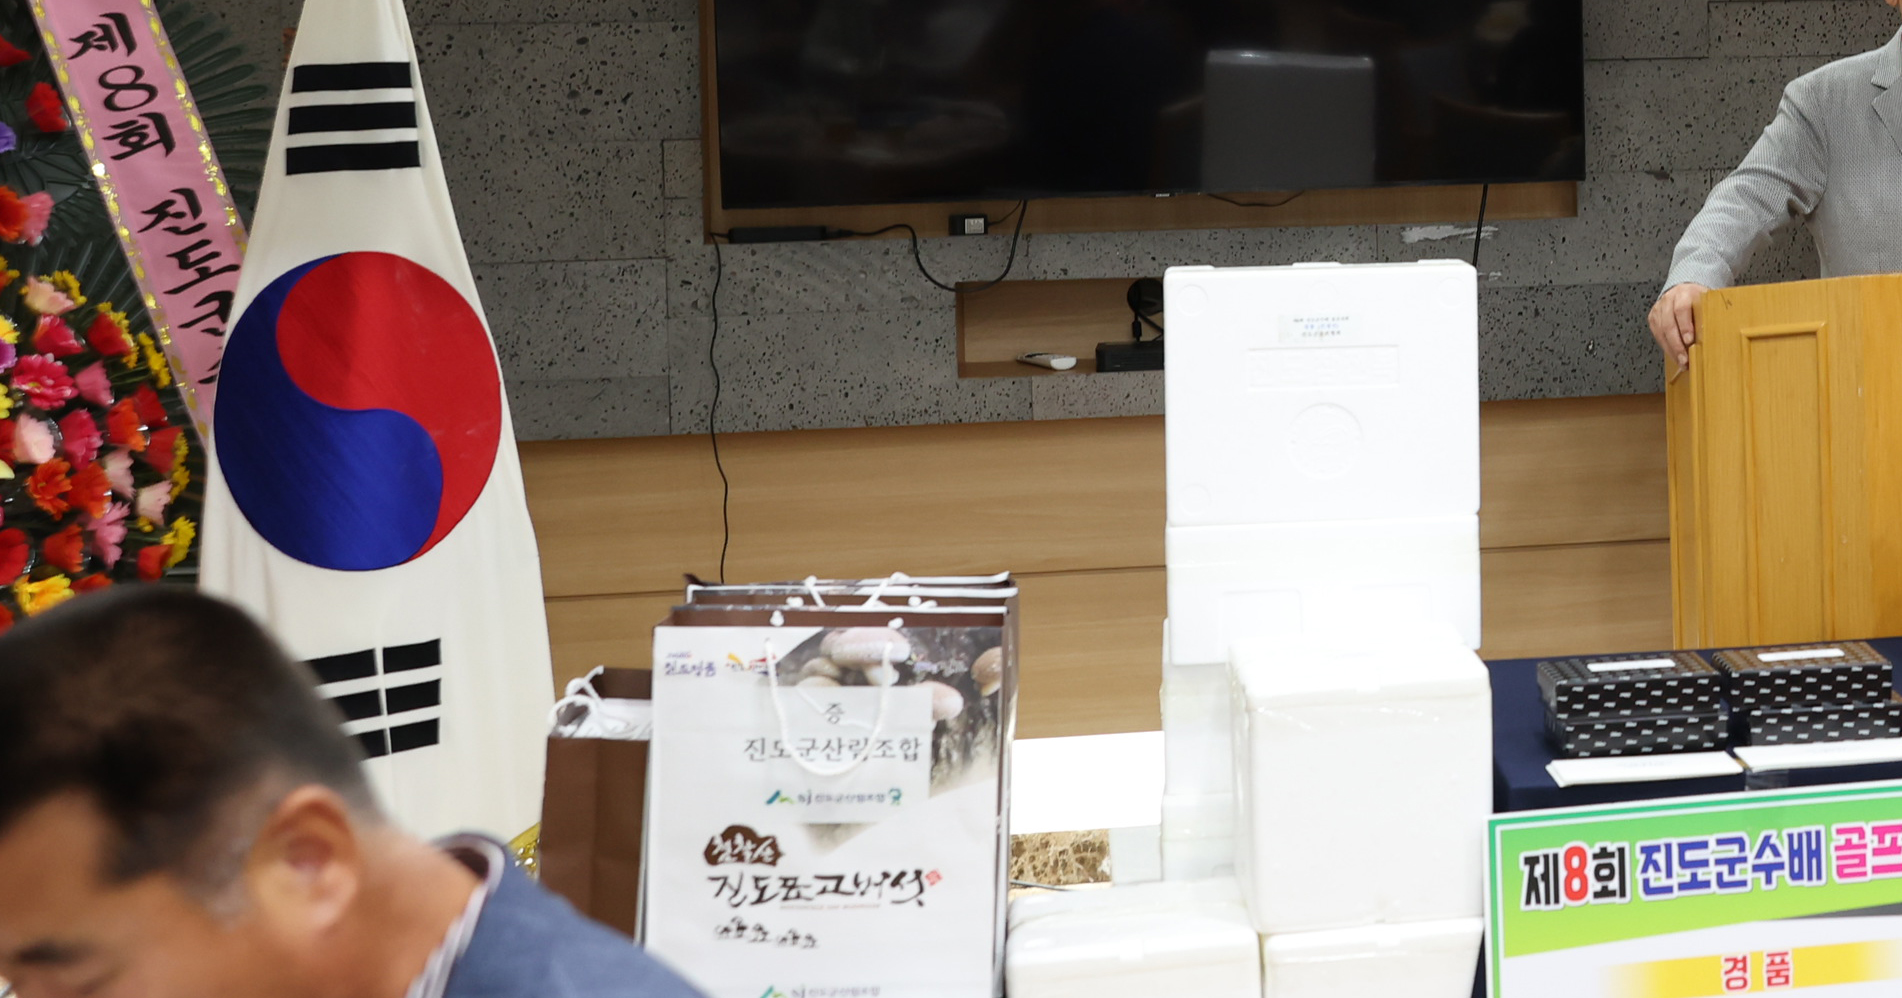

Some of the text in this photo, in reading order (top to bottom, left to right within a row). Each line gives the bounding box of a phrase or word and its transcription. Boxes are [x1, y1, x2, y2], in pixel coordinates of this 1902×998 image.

[67, 12, 177, 161] 제8회
[1522, 844, 1628, 908] 제8회
[1639, 828, 1825, 896] 진도군수배
